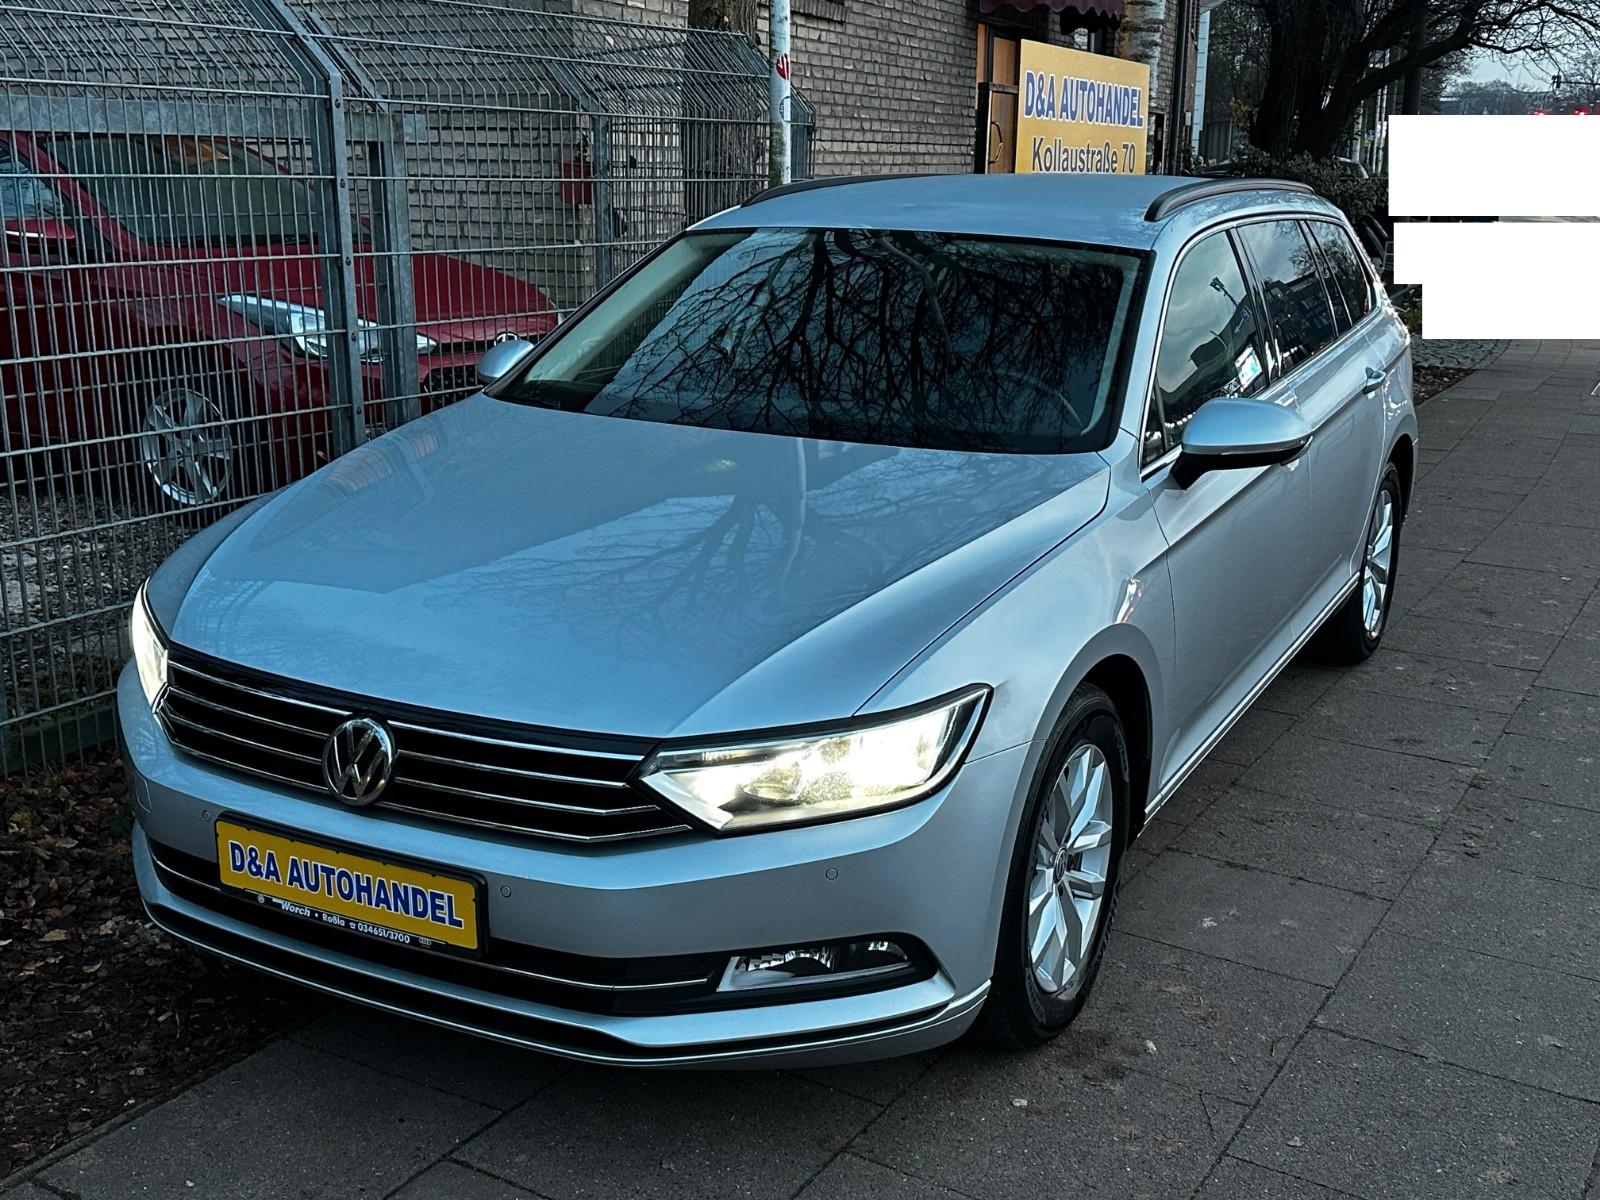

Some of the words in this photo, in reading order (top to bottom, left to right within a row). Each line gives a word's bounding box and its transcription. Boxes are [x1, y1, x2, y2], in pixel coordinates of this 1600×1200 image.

[1024, 70, 1056, 120] D&A
[1060, 76, 1144, 128] AUTOHANDEL
[1032, 137, 1118, 174] Kollaustraße
[1122, 143, 1136, 174] 70
[325, 720, 390, 803] VW
[229, 840, 282, 884] D&A
[287, 856, 464, 929] AUTOHANDEL
[280, 900, 311, 918] Worch
[357, 922, 410, 944] 034651/3700
